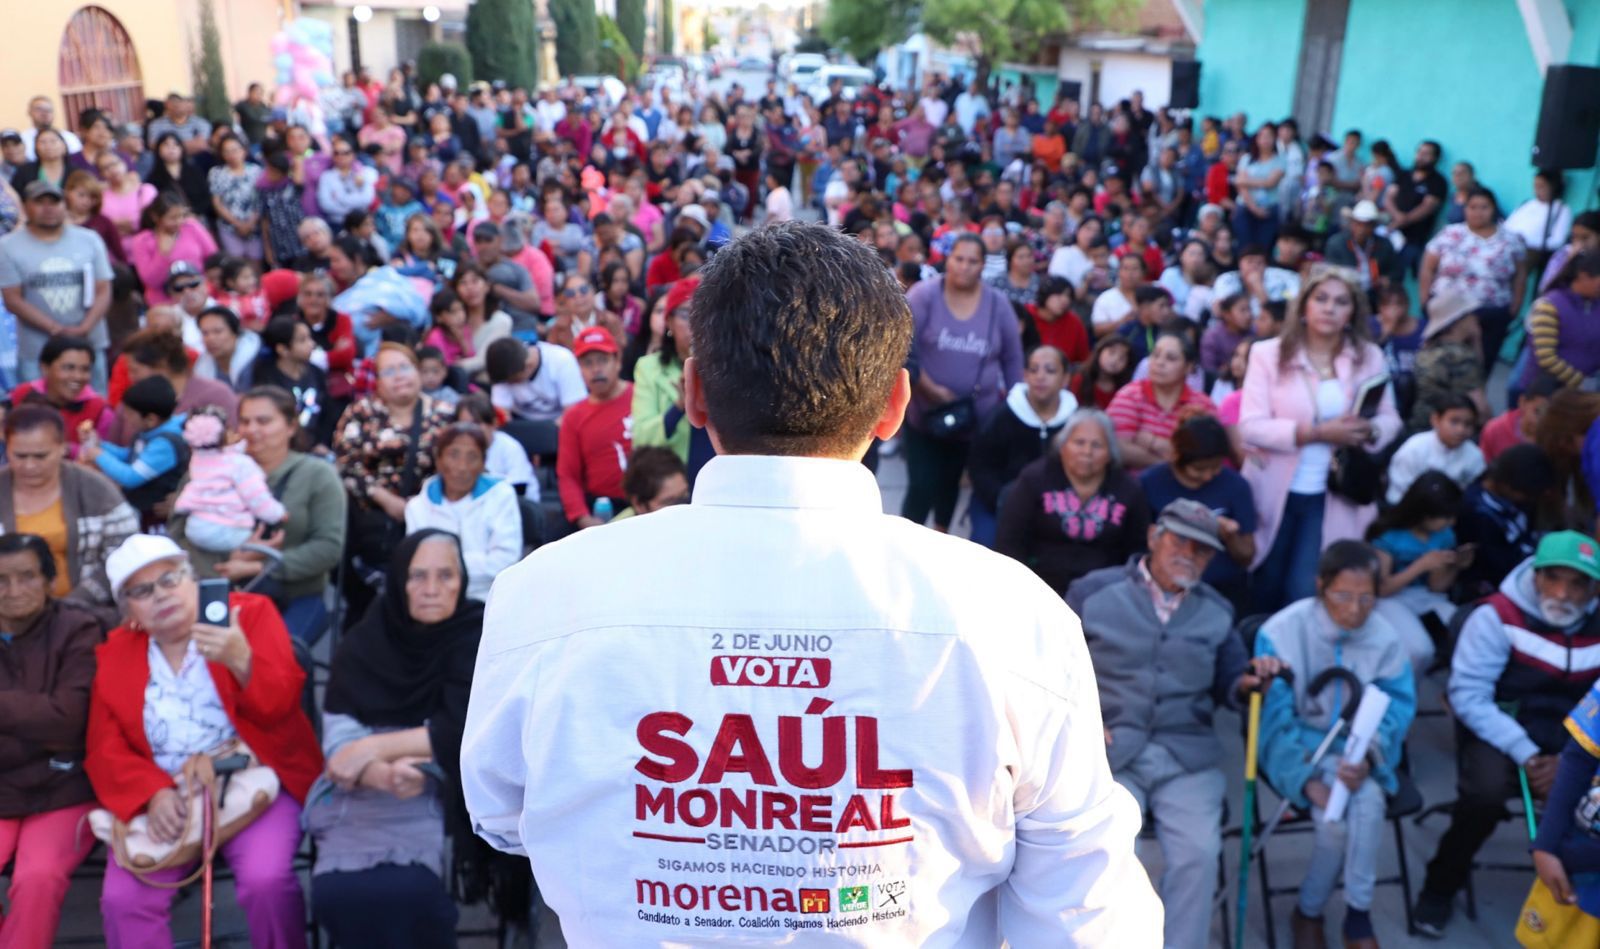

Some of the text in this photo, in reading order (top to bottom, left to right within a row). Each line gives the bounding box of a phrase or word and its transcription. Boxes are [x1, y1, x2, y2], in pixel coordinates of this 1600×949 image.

[712, 633, 833, 652] 2 DE JUNIO
[720, 657, 820, 686] VOTA
[634, 696, 914, 789] SAÚL
[635, 784, 911, 833] MONREAL
[706, 833, 837, 855] SENADOR
[658, 858, 882, 878] SIGAMOS HACIENDO HISTORIA
[635, 878, 798, 913] morena
[802, 898, 826, 912] PT
[877, 881, 906, 895] VOTA
[638, 908, 906, 930] Candidato a Senador. Coalición Sigamos Haciendo Historia
